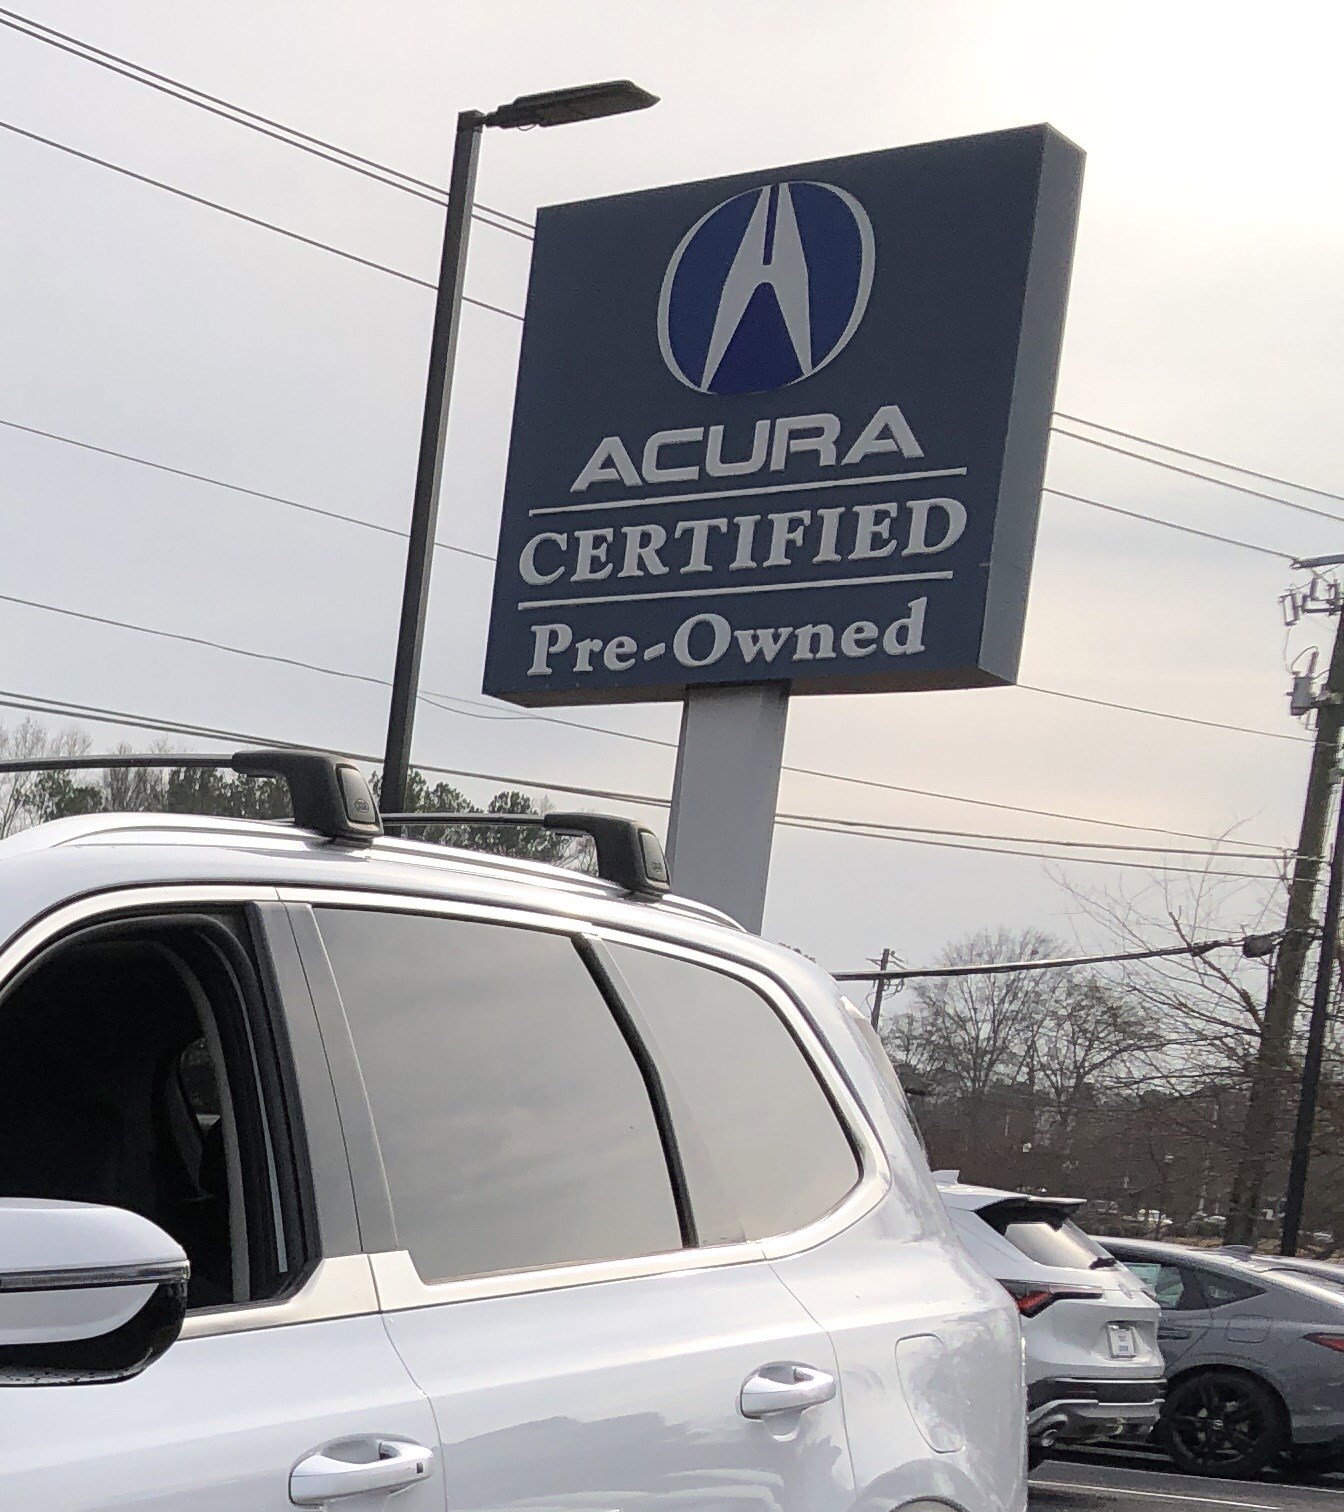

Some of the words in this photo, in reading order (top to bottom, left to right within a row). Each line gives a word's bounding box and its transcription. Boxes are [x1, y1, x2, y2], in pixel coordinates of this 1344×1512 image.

[571, 405, 925, 493] ACURA
[518, 498, 967, 586] CERTIFIED
[526, 597, 928, 677] Pre-Owned
